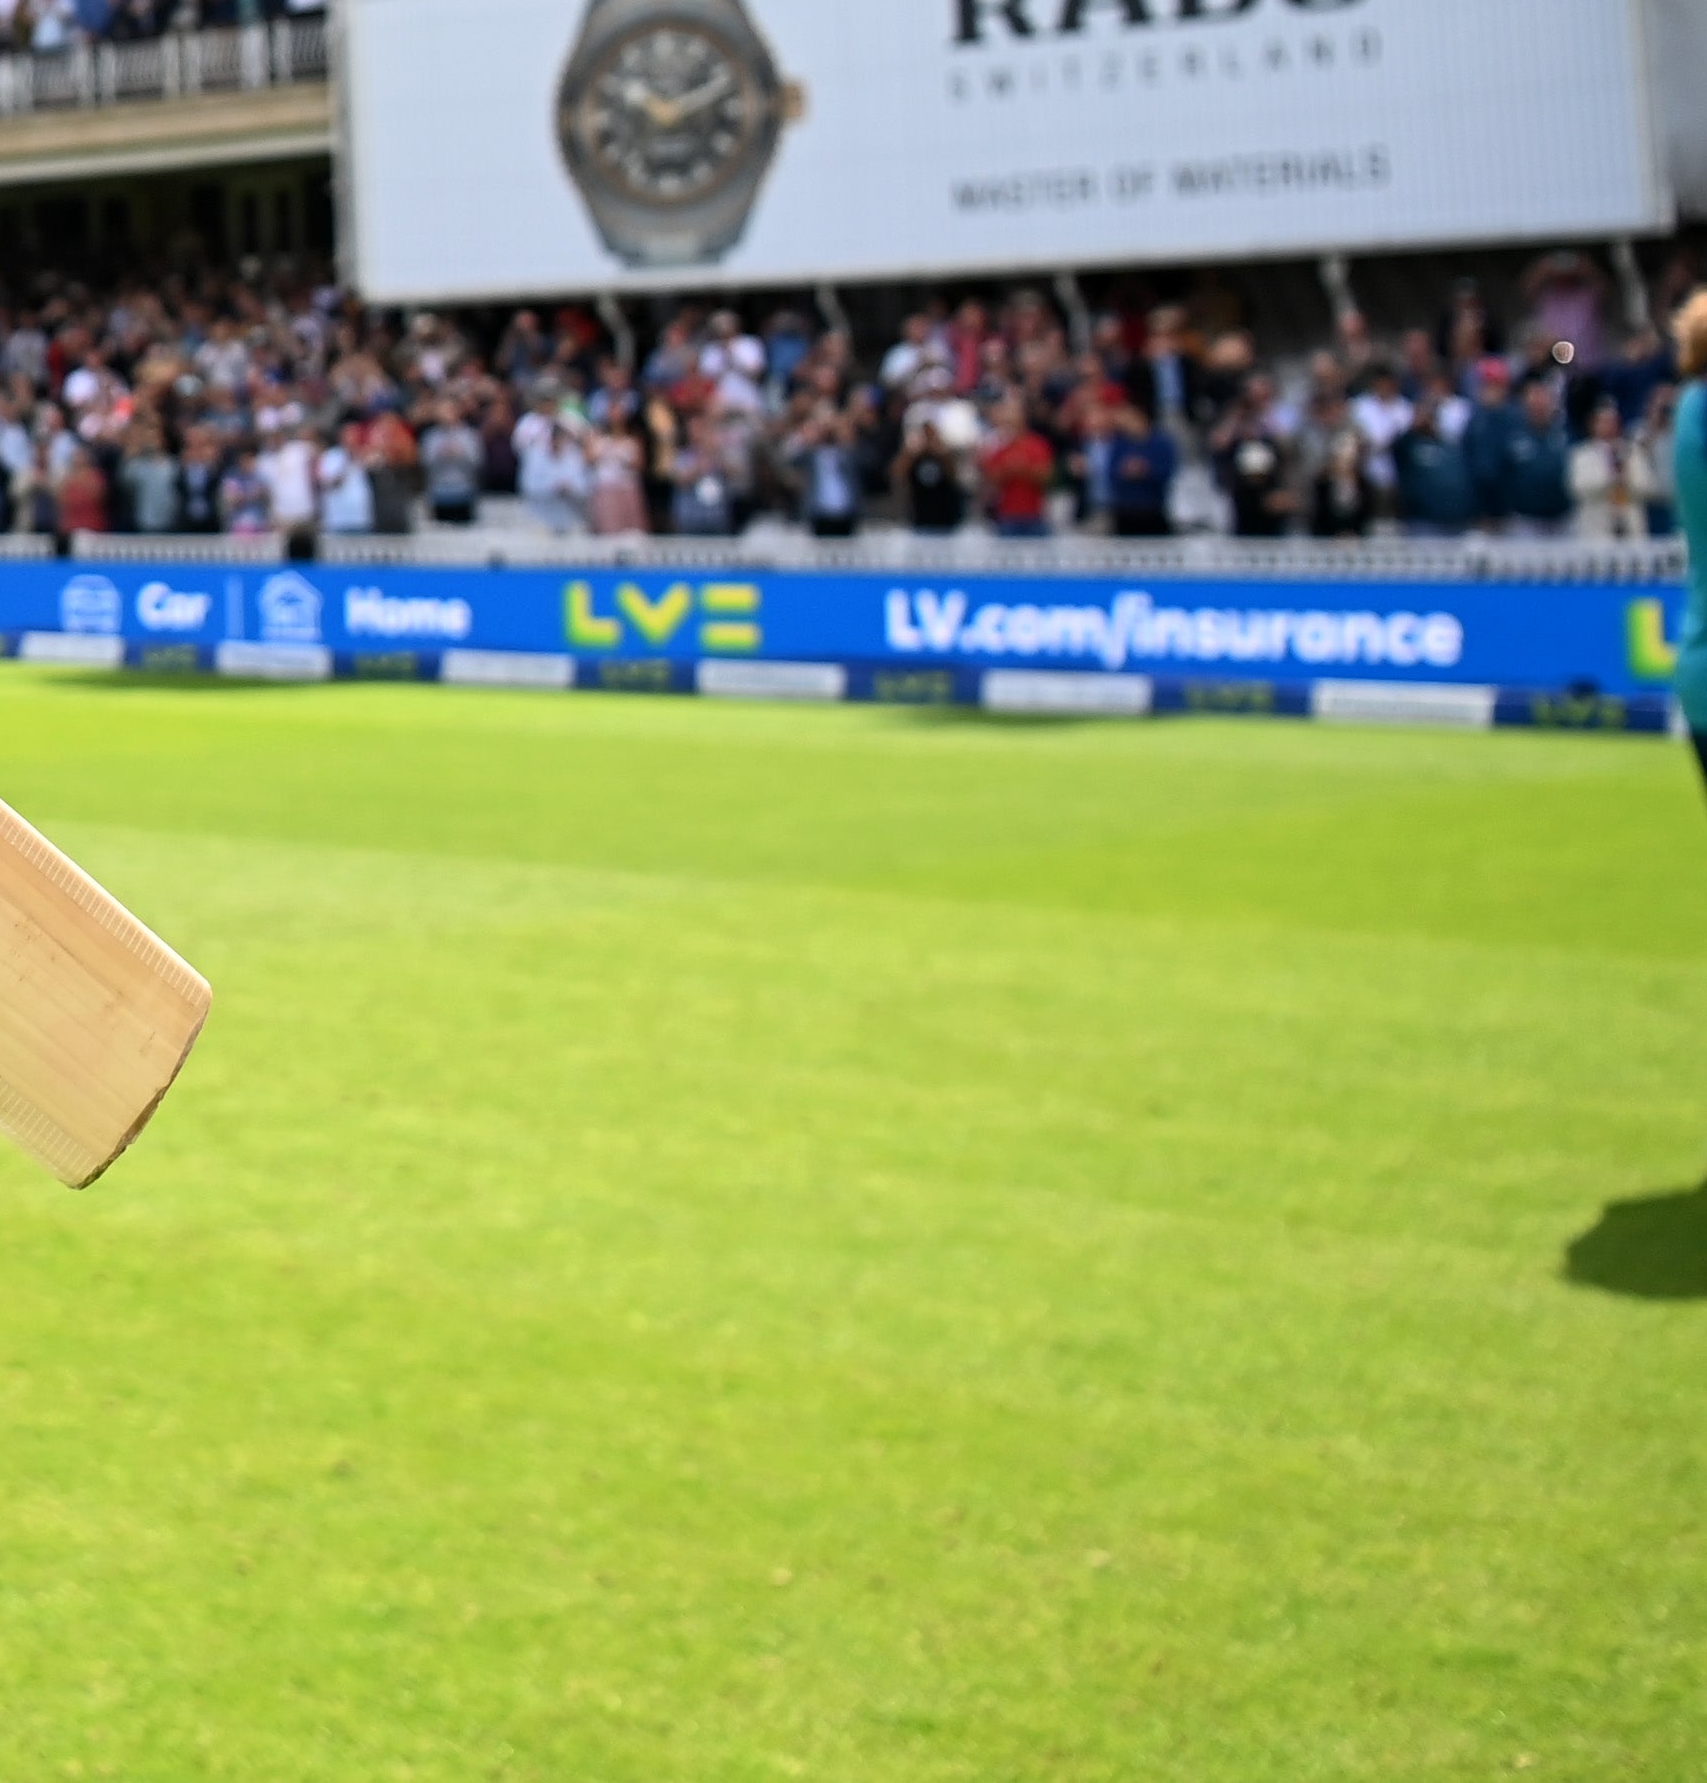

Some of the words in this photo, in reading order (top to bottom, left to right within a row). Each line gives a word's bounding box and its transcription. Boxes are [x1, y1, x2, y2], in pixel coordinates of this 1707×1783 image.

[1171, 144, 1391, 198] MATERIALS
[136, 580, 212, 632] Car
[344, 585, 471, 641] Home
[884, 588, 1465, 671] LV.com/insurance
